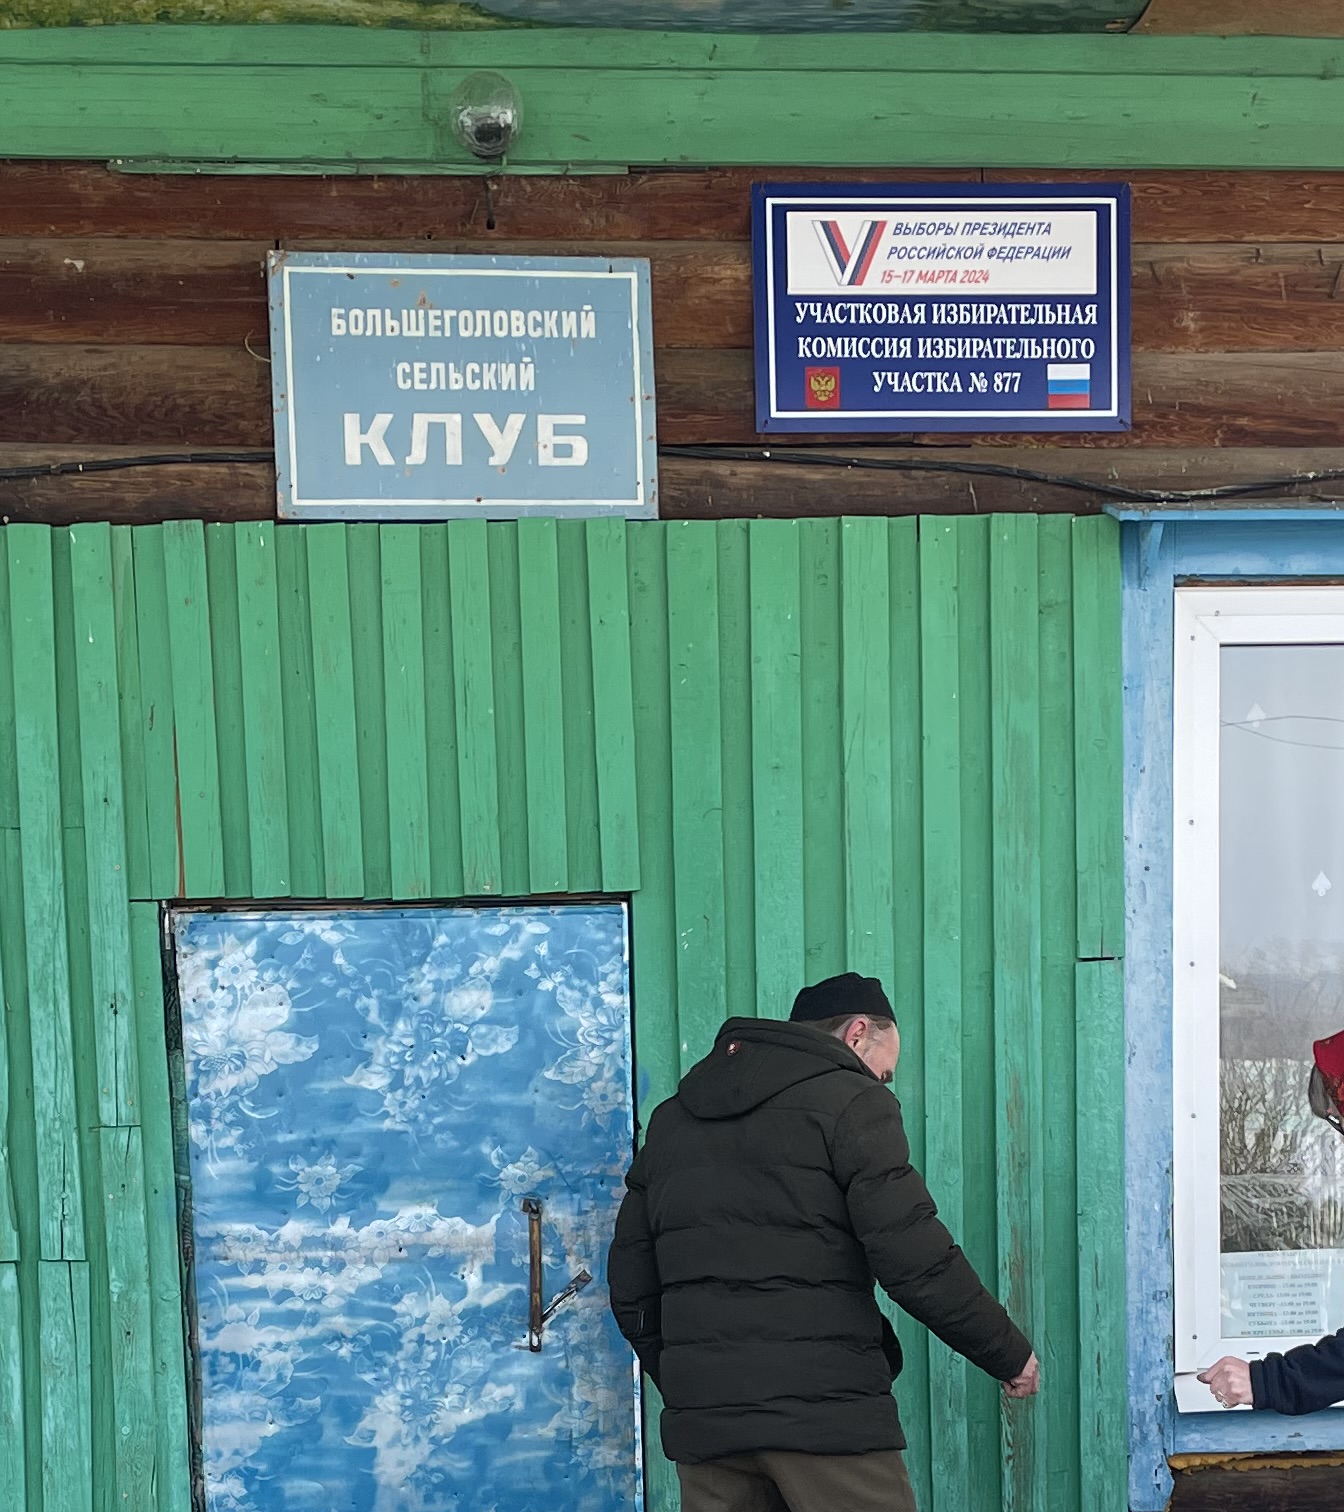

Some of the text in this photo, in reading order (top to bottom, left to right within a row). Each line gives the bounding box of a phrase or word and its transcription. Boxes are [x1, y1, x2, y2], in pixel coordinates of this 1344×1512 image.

[892, 221, 1052, 238] ВЫБОРЫ ПРЕЗИДЕНТА
[886, 242, 1073, 262] РОССИЙСКОЙ ФЕДЕРАЦИИ
[915, 269, 959, 284] МАРТА
[959, 269, 991, 284] 2024
[330, 304, 597, 339] БОЛЬШЕГОЛОВСКИЙ
[794, 302, 1098, 326] УЧАСТКОВАЯ ИЗБИРАТЕЛЬНАЯ
[797, 336, 1096, 359] КОМИССИЯ ИЗБИРАТЕЛЬНОГО
[396, 356, 536, 391] СЕЛЬСКИЙ
[872, 371, 1022, 394] УЧАСТКА № 877
[343, 412, 589, 467] КЛУБ
